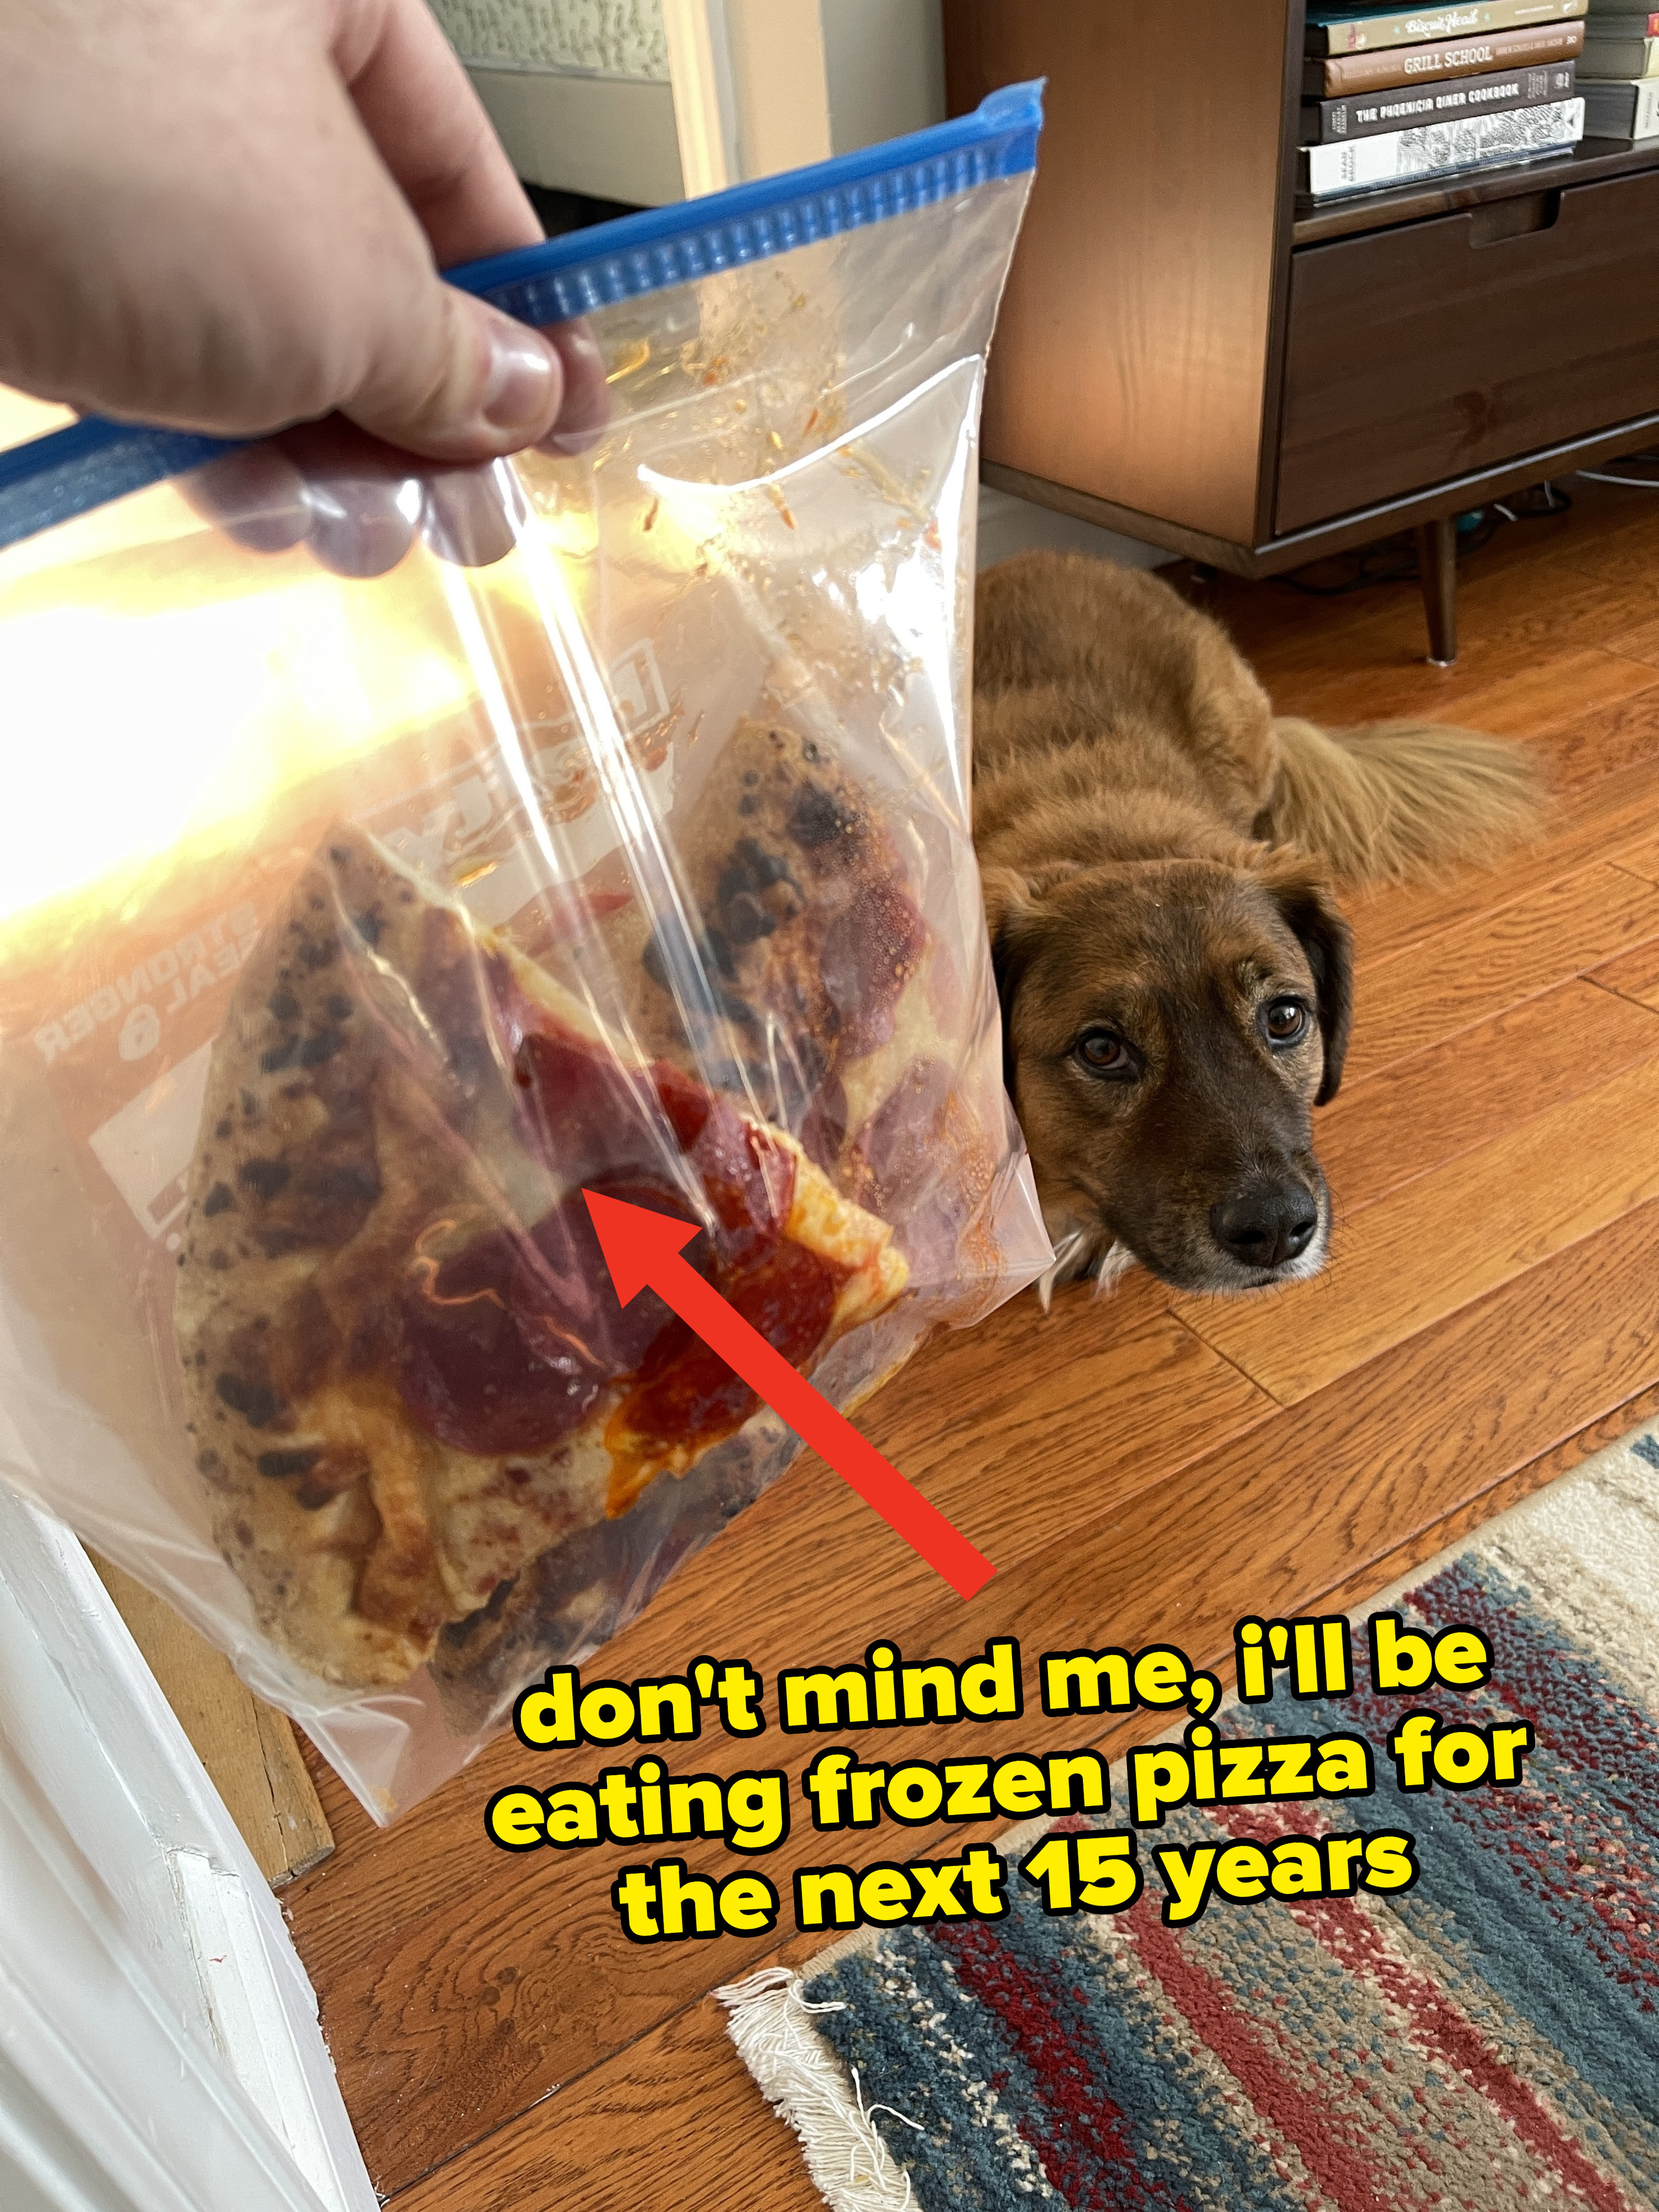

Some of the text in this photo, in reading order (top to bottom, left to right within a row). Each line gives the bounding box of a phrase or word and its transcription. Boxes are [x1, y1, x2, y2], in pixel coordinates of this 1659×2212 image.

[1446, 9, 1479, 33] Head
[1404, 53, 1443, 74] GRILL
[1444, 46, 1494, 68] SCHOOL
[1355, 108, 1378, 123] THE
[1379, 98, 1434, 119] PHOENICIA
[1436, 92, 1467, 109] DINER
[1468, 83, 1519, 103] COOKBOOK
